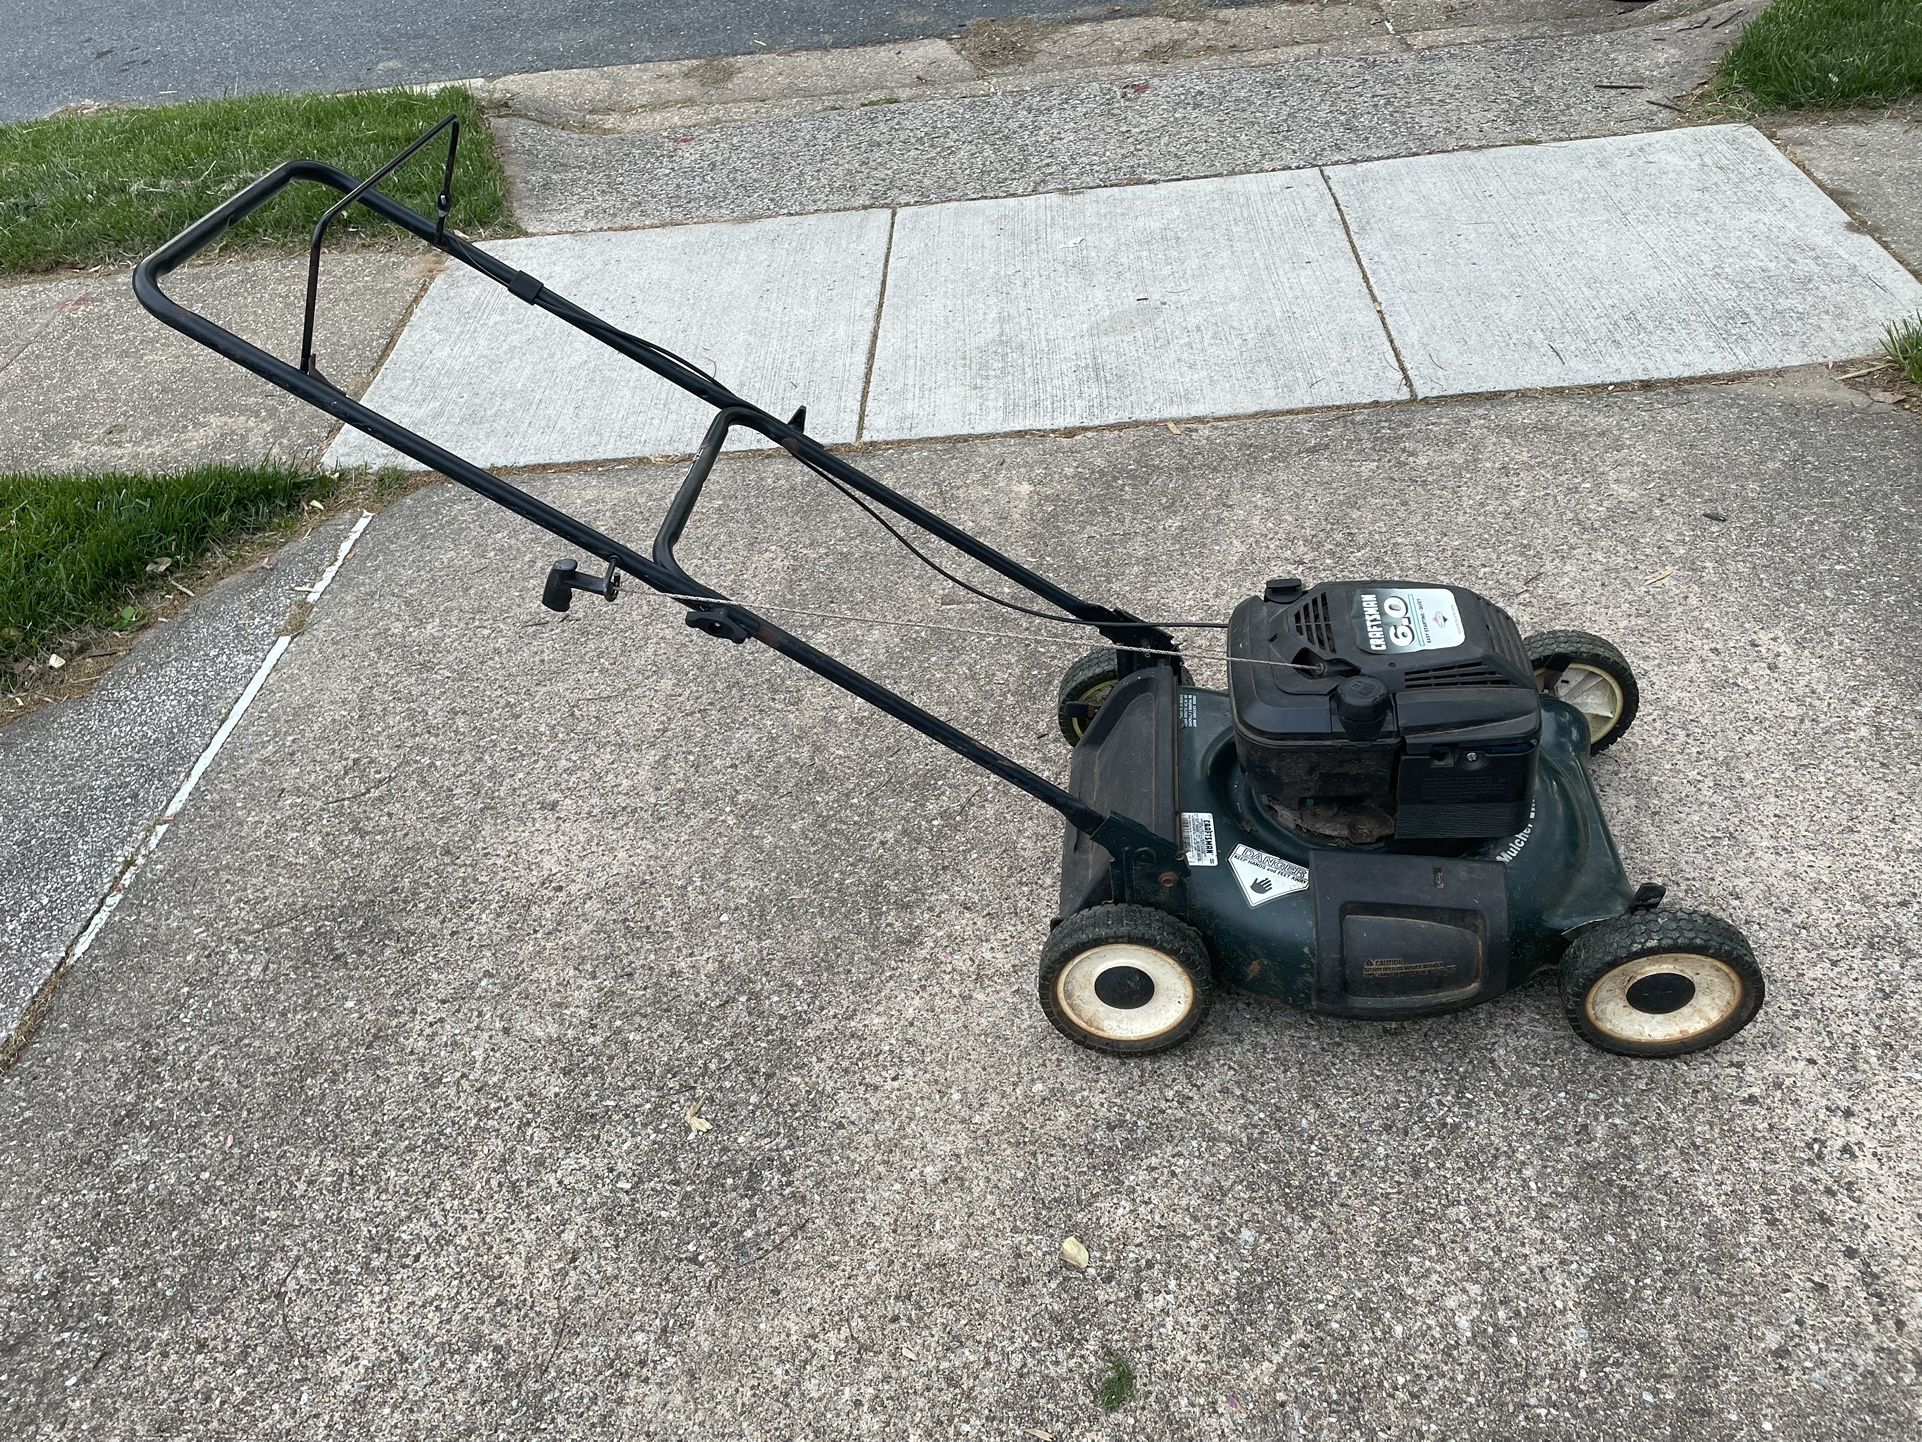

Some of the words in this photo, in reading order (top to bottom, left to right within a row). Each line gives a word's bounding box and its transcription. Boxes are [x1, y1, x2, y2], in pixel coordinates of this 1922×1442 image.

[1384, 596, 1415, 647] 6.0
[1416, 598, 1424, 610] QUIET
[1361, 595, 1387, 651] CRAFTSMAN
[1204, 819, 1214, 854] CRAFTSMAN
[1496, 823, 1533, 865] Mulcher
[1233, 854, 1248, 863] KEEP
[1248, 860, 1266, 870] HANDS
[1277, 870, 1291, 879] FEET
[1291, 876, 1307, 884] AWAY
[1241, 848, 1307, 878] DANGER
